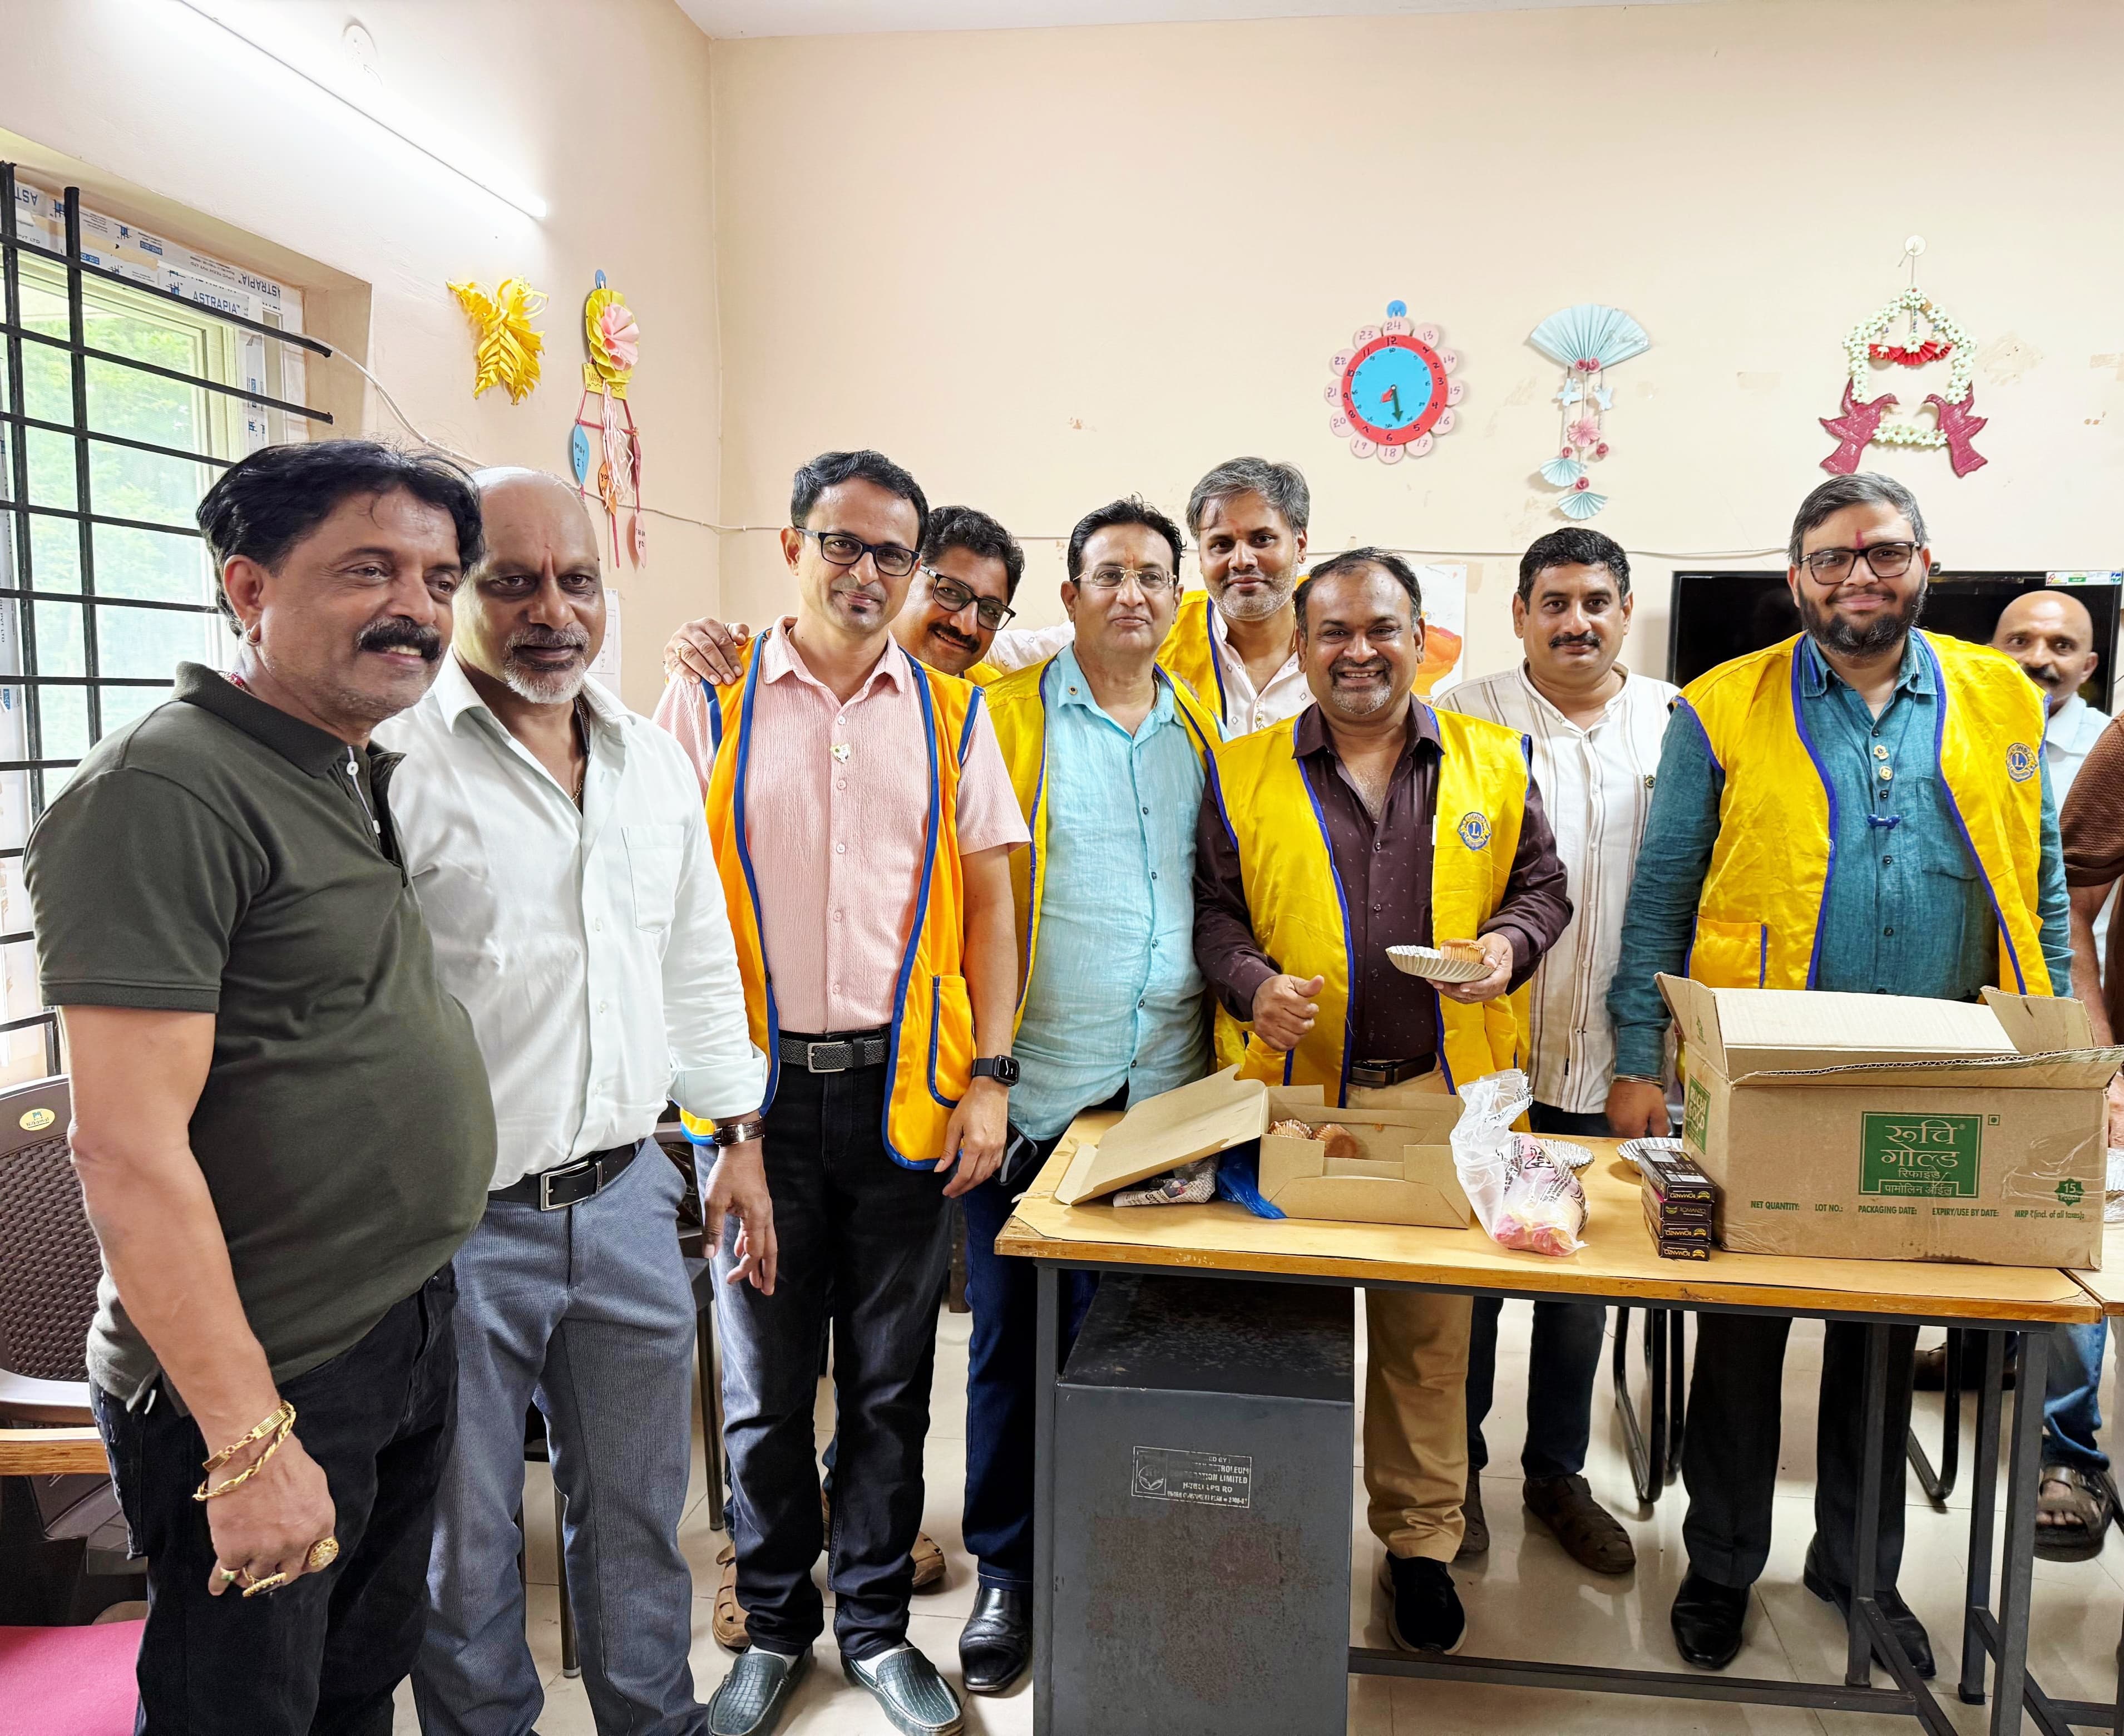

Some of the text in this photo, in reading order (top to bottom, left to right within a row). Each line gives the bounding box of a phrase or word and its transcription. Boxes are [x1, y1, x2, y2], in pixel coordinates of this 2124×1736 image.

[1387, 320, 1401, 331] 24
[1360, 331, 1373, 339] 23
[1424, 331, 1433, 341] 13
[1387, 336, 1397, 346] 12
[1335, 357, 1346, 365] 22
[1327, 387, 1336, 397] 21
[1349, 410, 1355, 418] 8
[1333, 417, 1346, 427] 20
[1439, 416, 1449, 425] 16
[1355, 440, 1367, 450] 19
[1385, 448, 1396, 457] 18
[1880, 1142, 1960, 1168] गोल्ड
[2064, 1183, 2076, 1193] 15
[1766, 1201, 1800, 1211] QUANTITY:
[1815, 1204, 1843, 1212] LOT NO.:
[1858, 1205, 1917, 1215] PACKAGING DATE:
[1932, 1207, 1999, 1217] EXPIRY/USE BY DATE:
[2014, 1210, 2028, 1218] MRP
[2049, 1210, 2055, 1218] of
[1219, 1474, 1248, 1484] LIMITED
